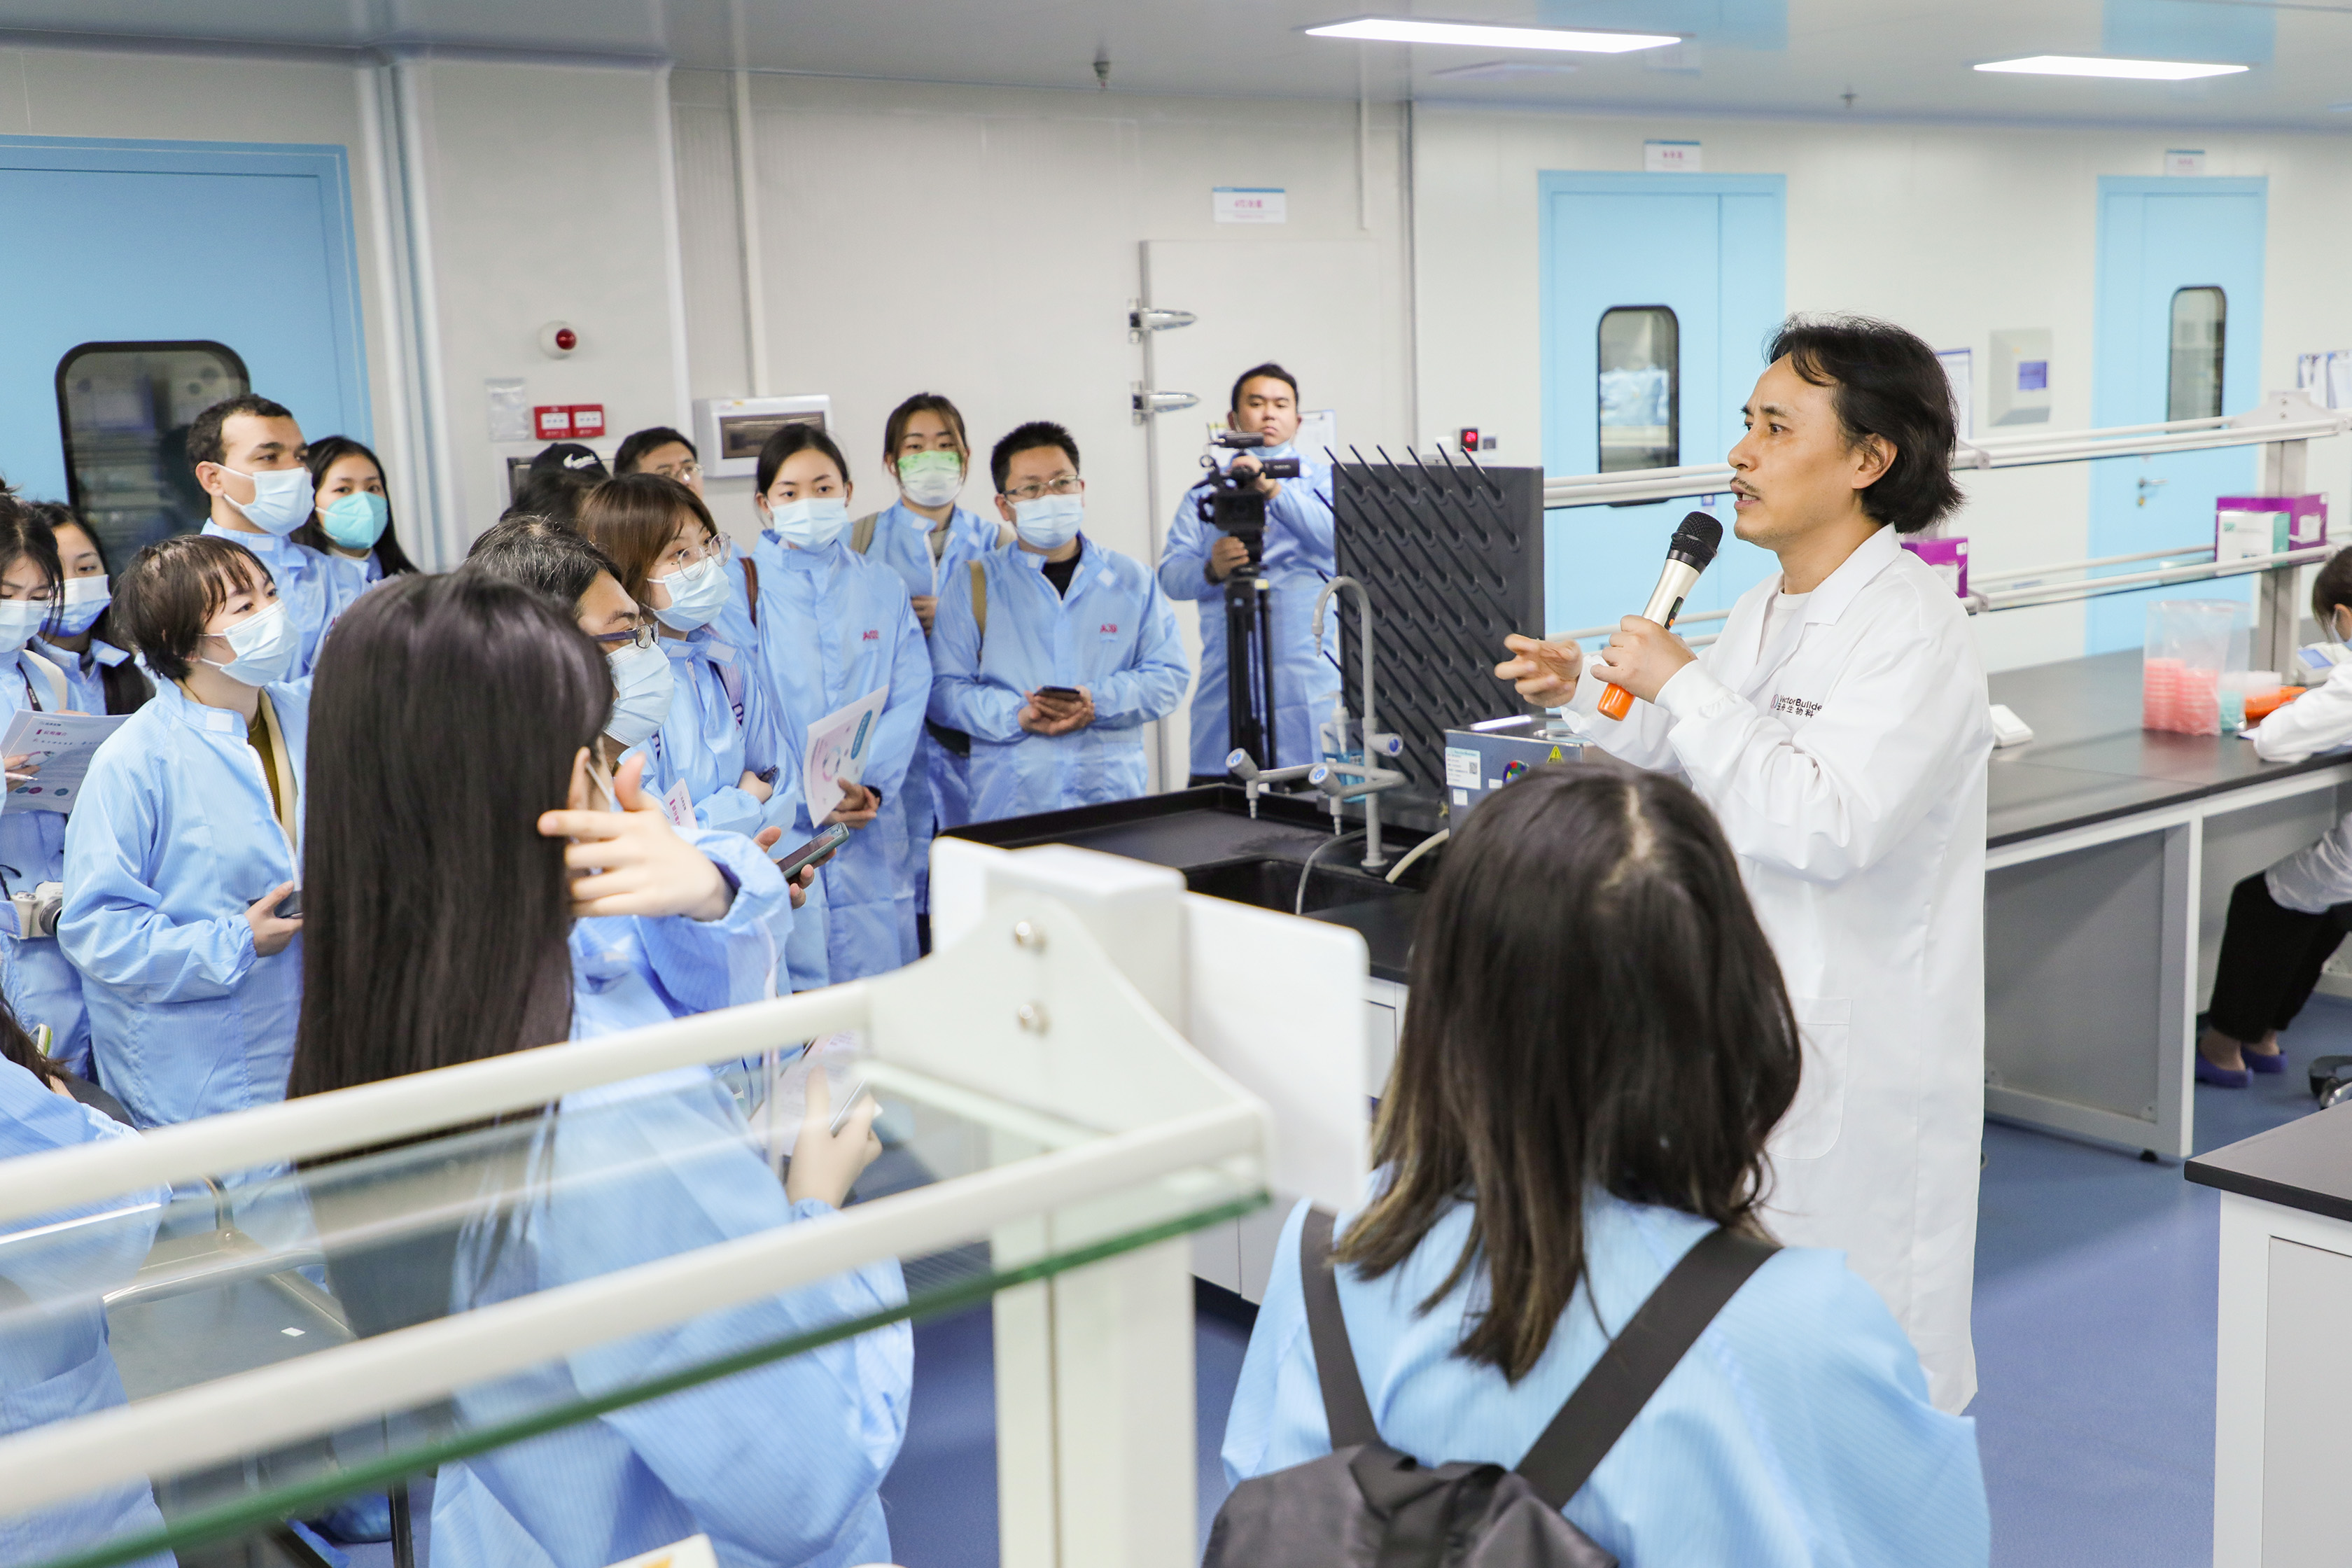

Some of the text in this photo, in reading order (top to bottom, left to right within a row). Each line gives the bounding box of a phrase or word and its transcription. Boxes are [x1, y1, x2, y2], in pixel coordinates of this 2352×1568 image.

[1777, 703, 1814, 718] 云舟生物科
[1779, 695, 1822, 711] VectorBuilde
